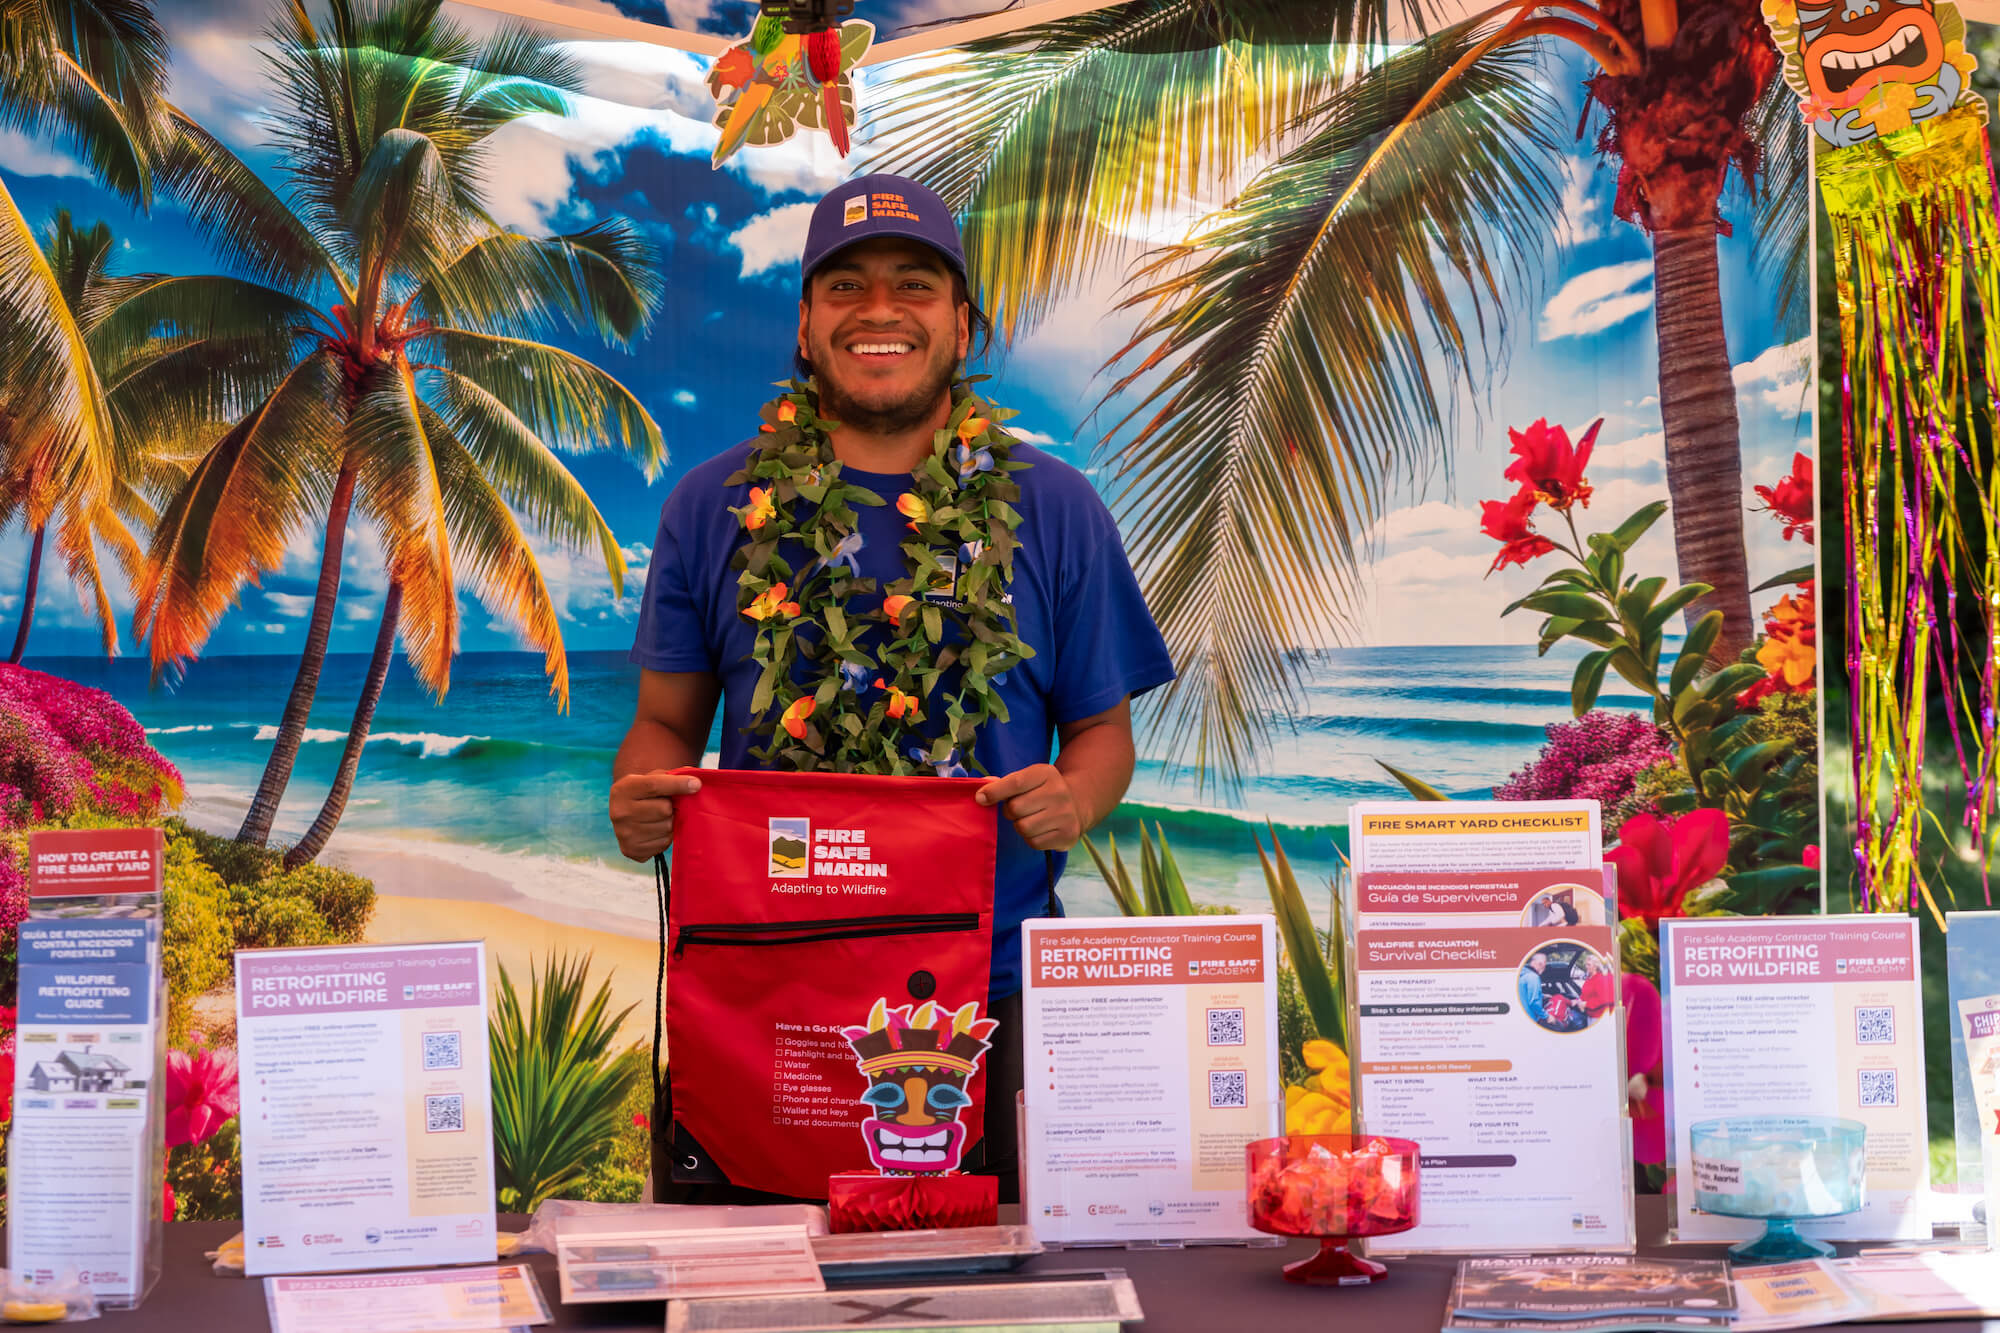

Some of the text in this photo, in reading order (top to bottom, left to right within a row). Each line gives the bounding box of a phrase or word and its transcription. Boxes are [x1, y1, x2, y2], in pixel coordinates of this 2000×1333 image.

[872, 193, 904, 202] FIRE
[872, 201, 909, 211] SAFE
[872, 210, 920, 222] MARIN
[1369, 817, 1584, 829] FIRE SMART YARD CHECKLIST
[816, 829, 865, 843] FIRE
[38, 851, 149, 863] HOW TO CREATE A
[814, 846, 871, 860] SAFE
[37, 862, 150, 874] FIRE SMART YARD
[814, 862, 887, 877] MARIN
[771, 883, 887, 895] Adapting to Wildfire
[1368, 892, 1517, 904] Guía de Supervivencia
[50, 931, 63, 939] DE
[66, 929, 144, 939] RENOVACIONES
[1040, 933, 1257, 946] Fire Safe Academy Contractor Training Course
[1684, 931, 1905, 944] Fire Safe Academy Contractor Training Course
[33, 939, 133, 949] CONTRA INCENDIOS
[1368, 940, 1478, 948] WILDFIRE EVACUATION
[51, 949, 116, 959] FORESTALES
[1041, 947, 1172, 963] RETROFITTING
[1369, 949, 1496, 961] Survival Checklist
[1685, 944, 1819, 961] RETROFITTING
[251, 956, 472, 974] Fire Safe Academy Contractor Training Course
[1686, 961, 1820, 977] FOR WILDFIRE
[1849, 966, 1905, 974] ACADEMY
[1042, 963, 1173, 980] FOR WILDFIRE
[1202, 967, 1256, 976] ACADEMY
[55, 975, 115, 985] WILDFIRE
[252, 971, 386, 992] RETROFITTING
[39, 987, 130, 997] RETROFITTING
[65, 999, 104, 1009] GUIDE
[252, 989, 388, 1008] FOR WILDFIRE
[776, 1023, 802, 1031] Have
[785, 1038, 818, 1047] Goggles
[838, 1041, 850, 1049] N9
[785, 1049, 825, 1059] Flashlight
[827, 1051, 842, 1060] and
[784, 1072, 822, 1080] Medicine
[783, 1084, 832, 1093] Eye glasses
[783, 1095, 809, 1103] Phone
[812, 1096, 828, 1104] and
[782, 1106, 808, 1114] Wallet
[830, 1108, 848, 1117] keys
[794, 1118, 809, 1126] and
[812, 1119, 859, 1128] documents
